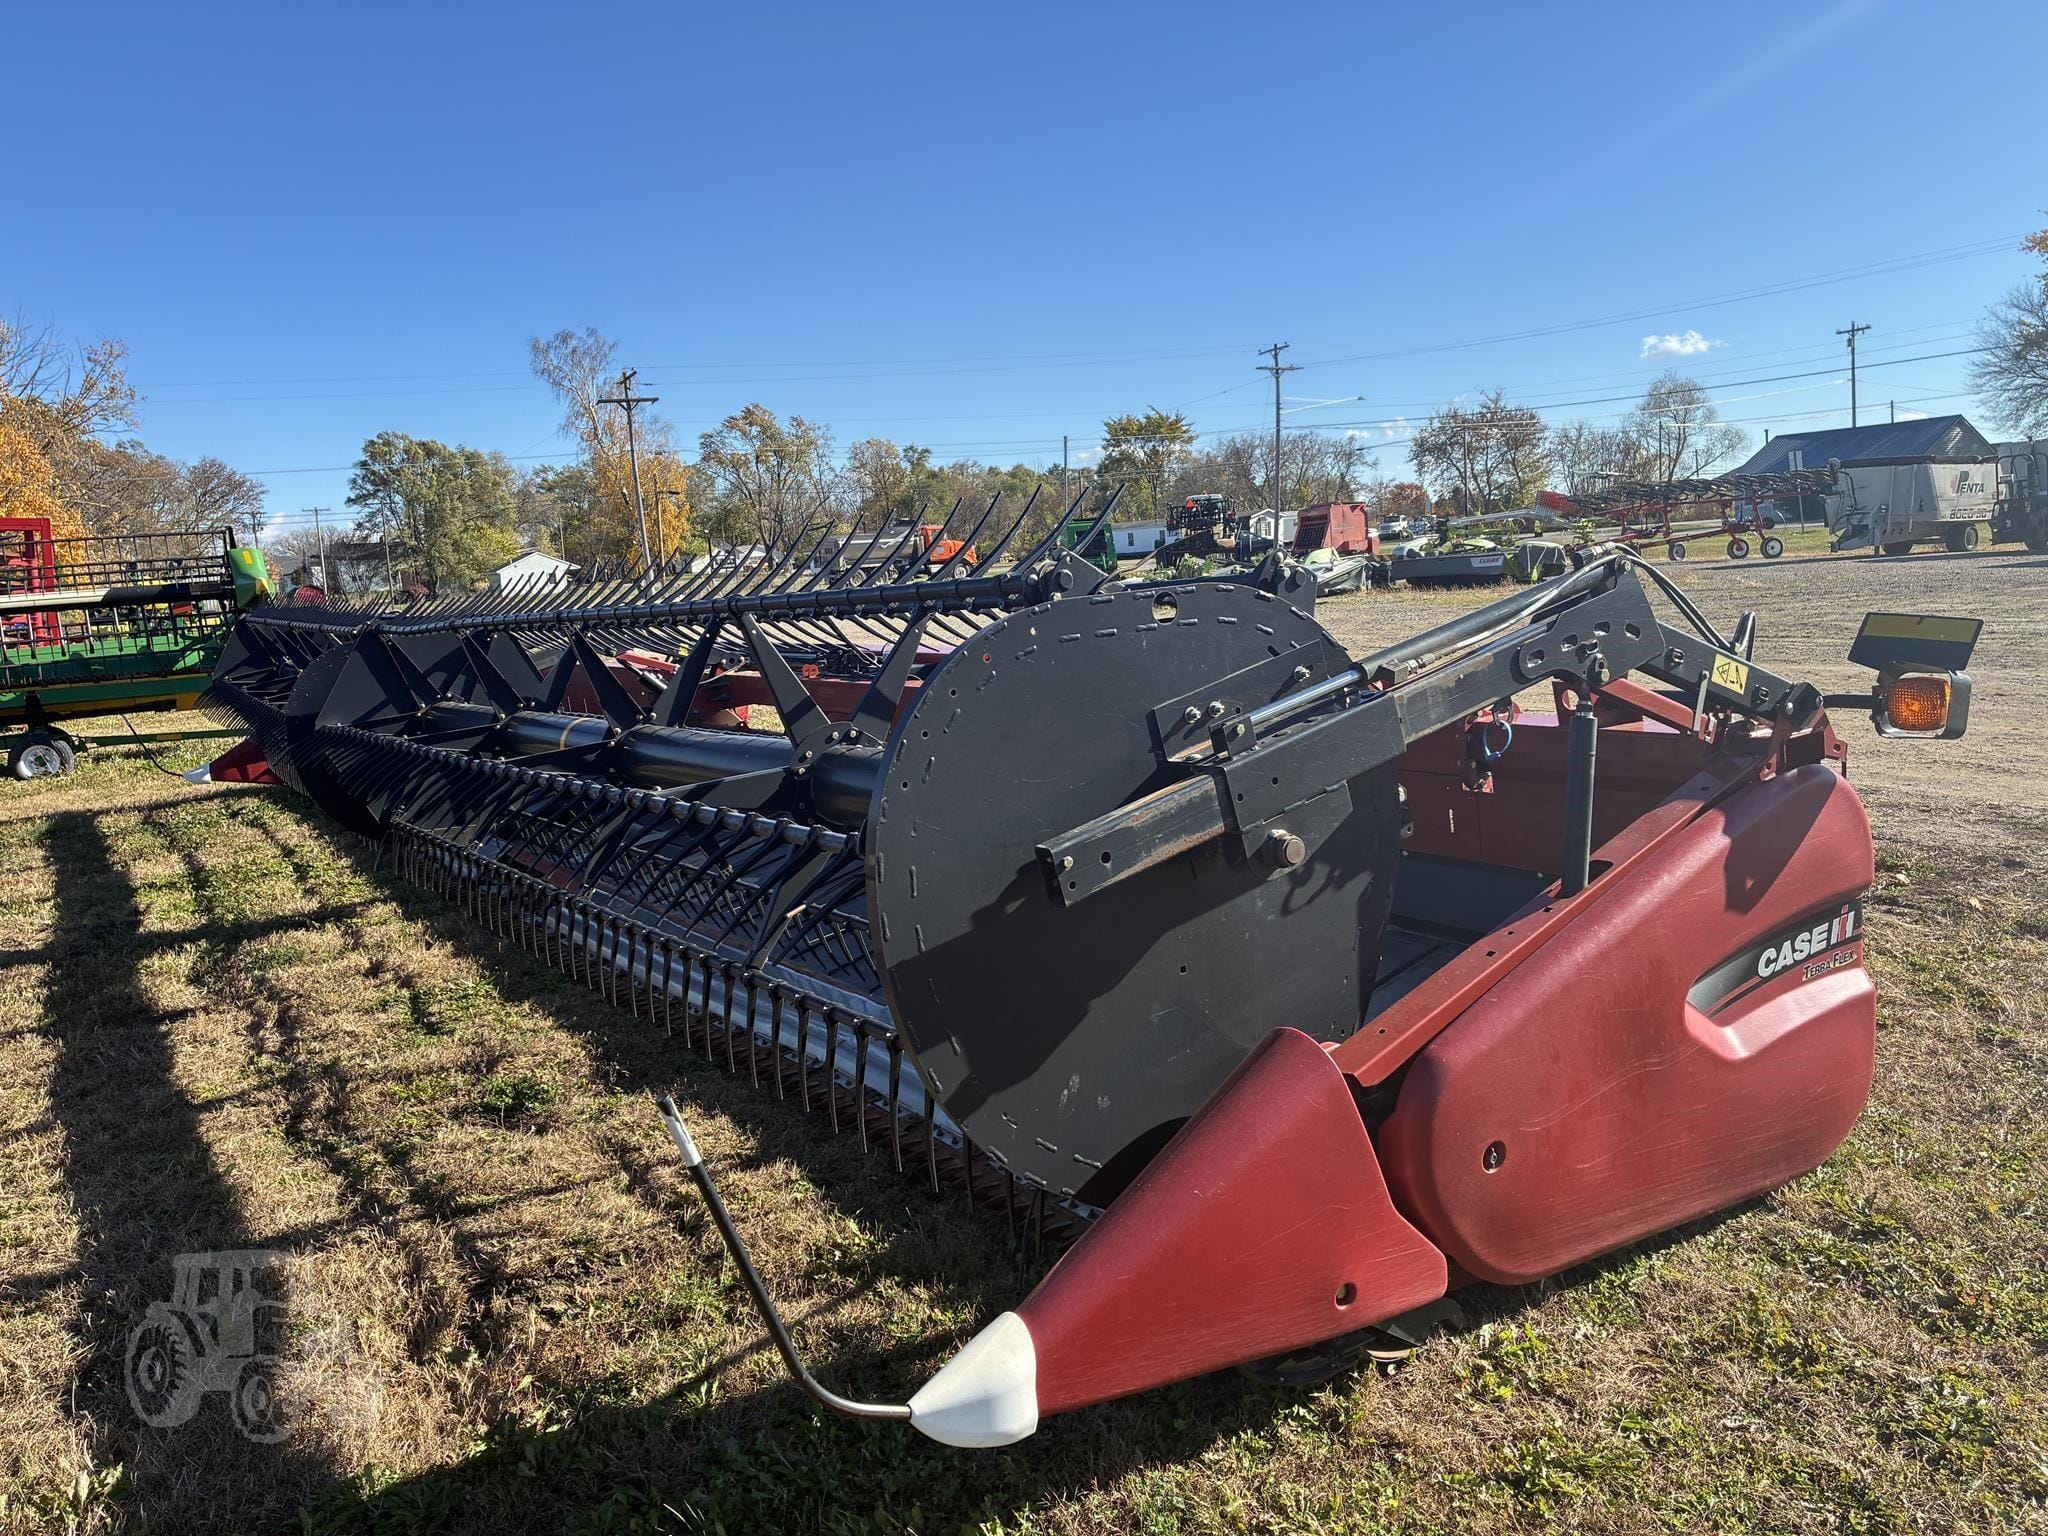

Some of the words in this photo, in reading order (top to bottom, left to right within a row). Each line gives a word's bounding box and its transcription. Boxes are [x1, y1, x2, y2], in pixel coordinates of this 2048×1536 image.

[1955, 470, 1985, 495] PENTA
[1757, 922, 1829, 978] CASE
[1803, 958, 1832, 980] TERRA
[1832, 949, 1857, 967] FLEX
